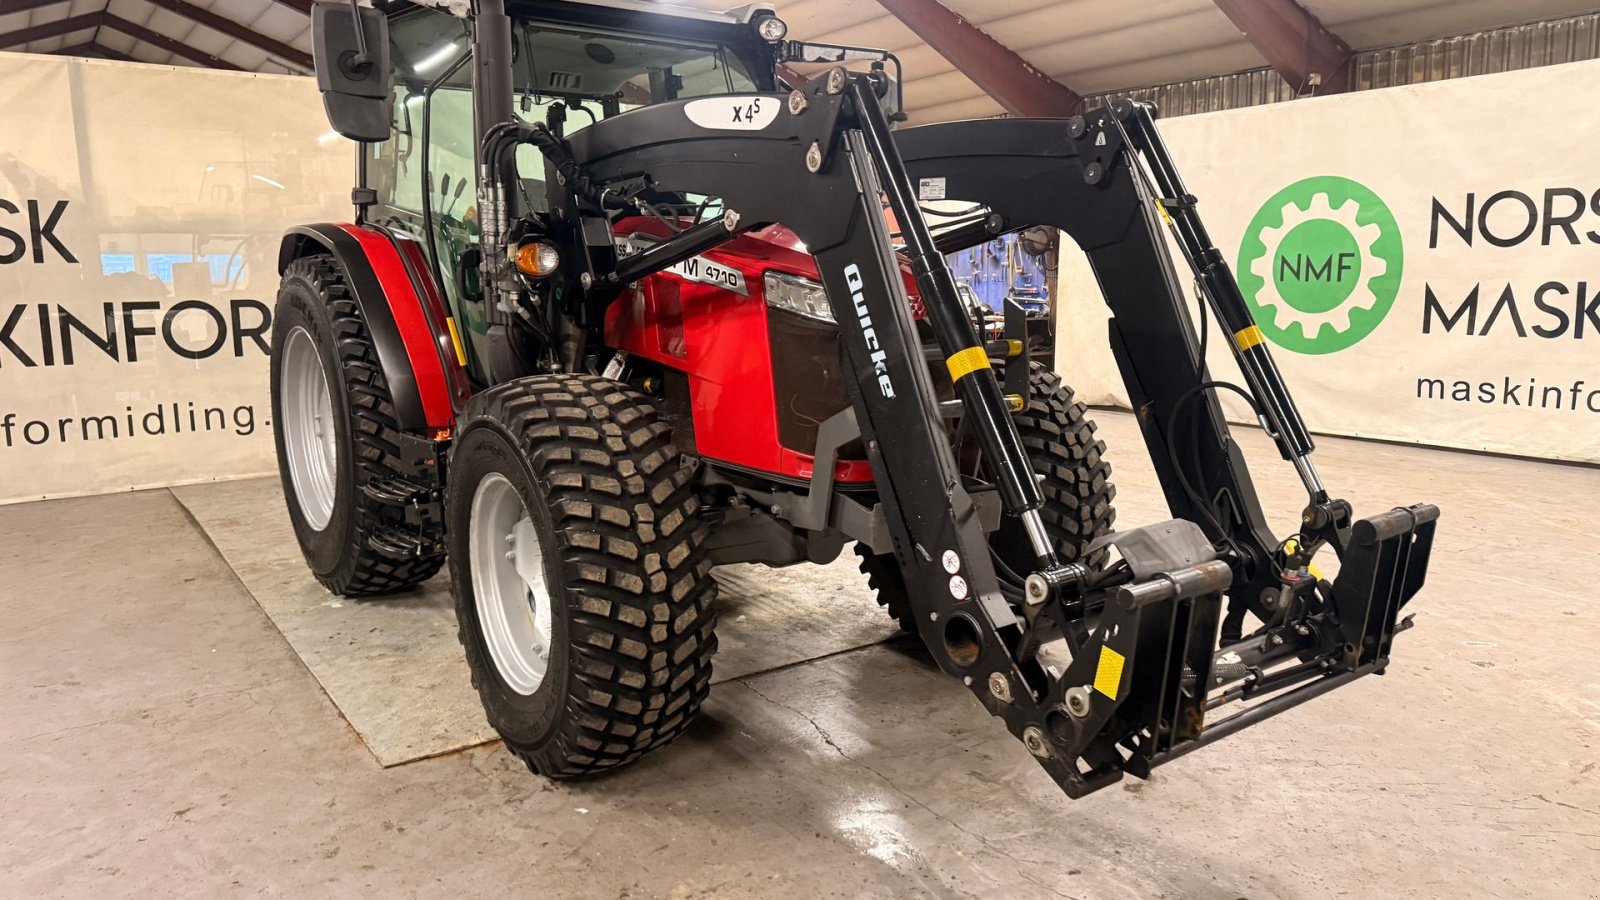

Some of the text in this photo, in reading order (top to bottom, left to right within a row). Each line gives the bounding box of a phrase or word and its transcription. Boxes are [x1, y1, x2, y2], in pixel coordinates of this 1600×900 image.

[706, 266, 737, 287] 4710
[1280, 253, 1355, 282] NMF
[844, 263, 895, 398] Quicke
